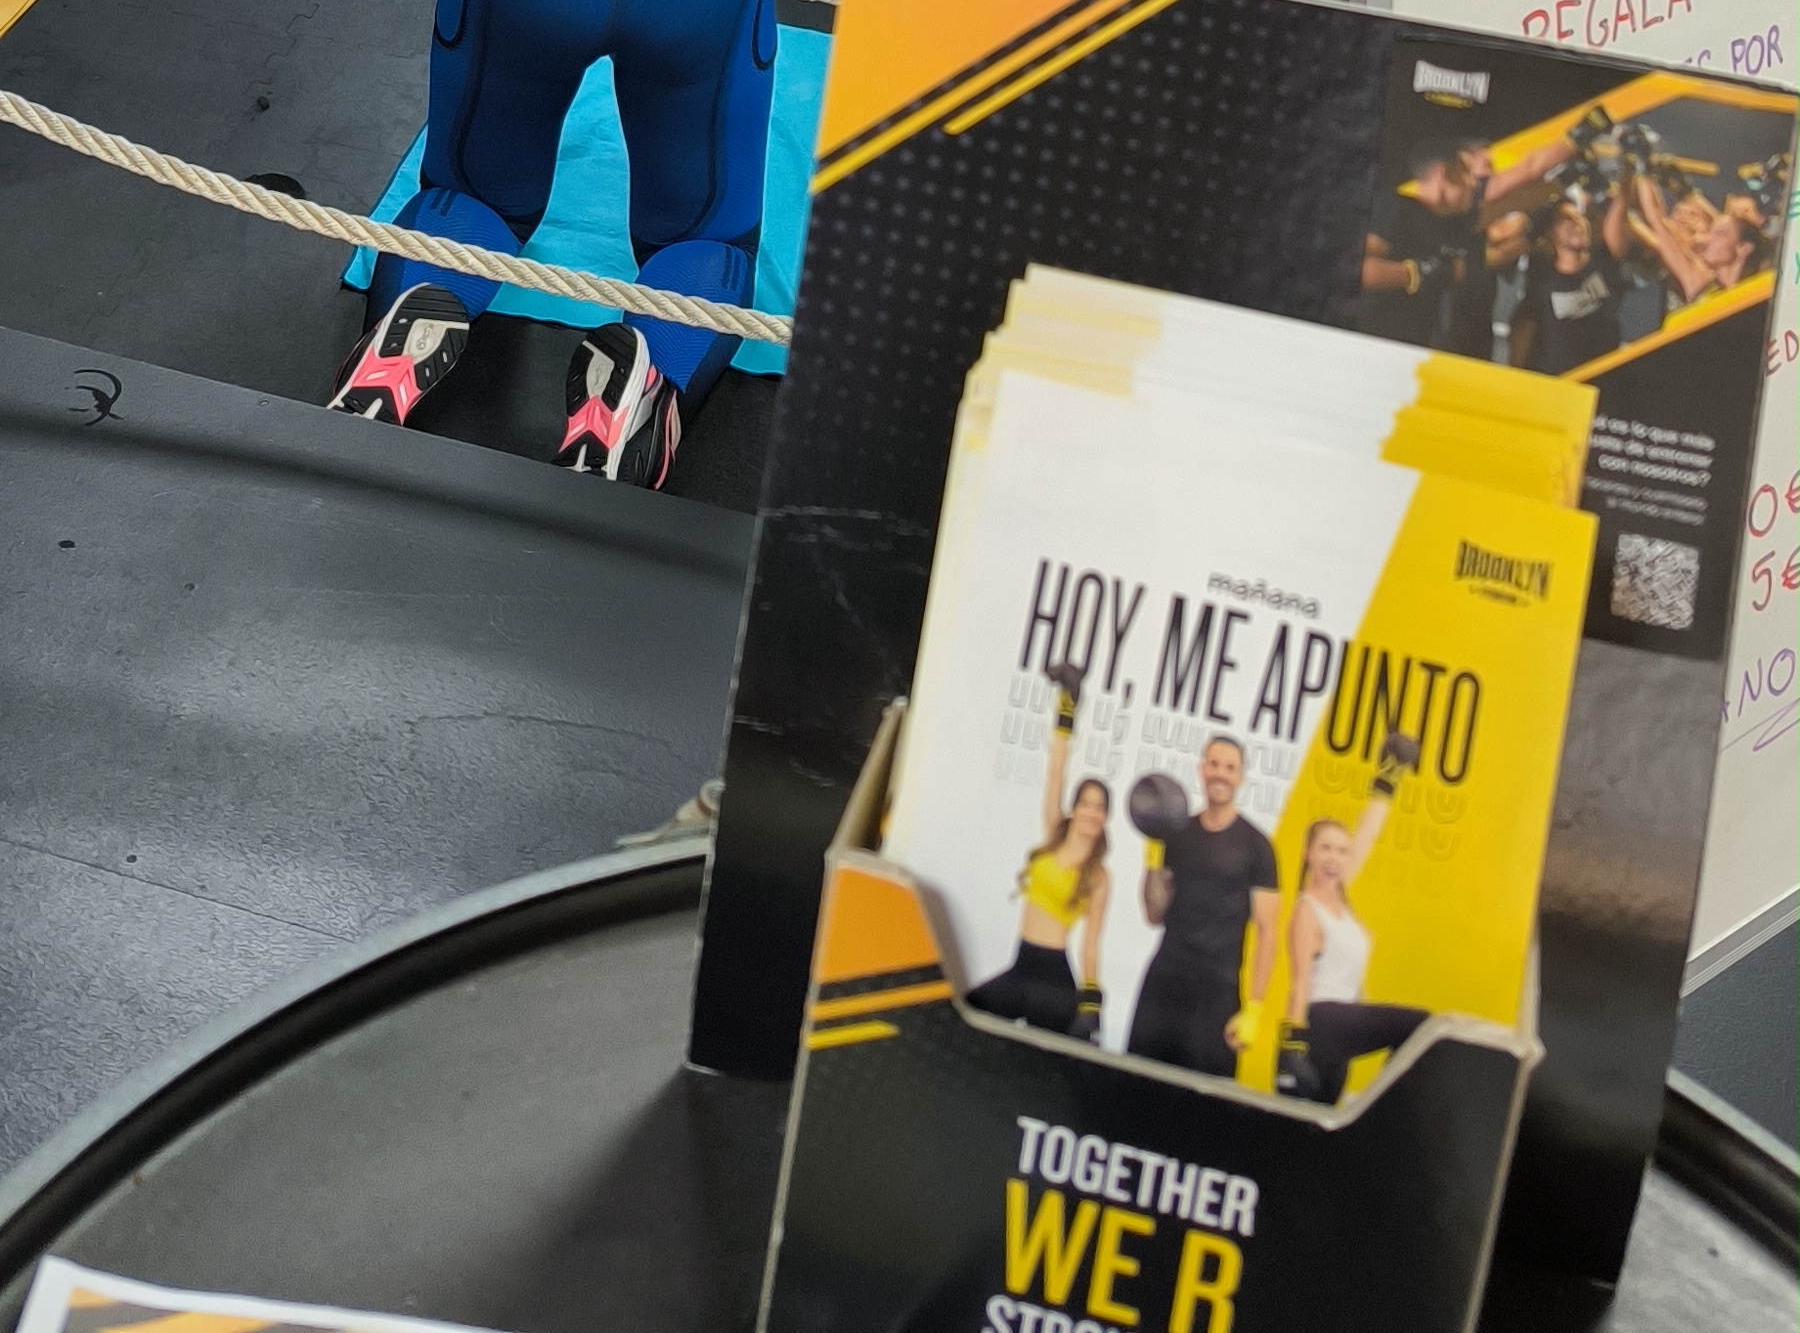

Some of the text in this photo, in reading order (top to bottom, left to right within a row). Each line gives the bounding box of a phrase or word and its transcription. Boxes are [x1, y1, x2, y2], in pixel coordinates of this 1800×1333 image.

[1730, 24, 1784, 75] POR
[1207, 572, 1321, 621] mañana
[1021, 558, 1482, 788] HOY, ME APUNTO
[1016, 1114, 1260, 1237] TOGETHER
[1005, 1177, 1244, 1333] WE R
